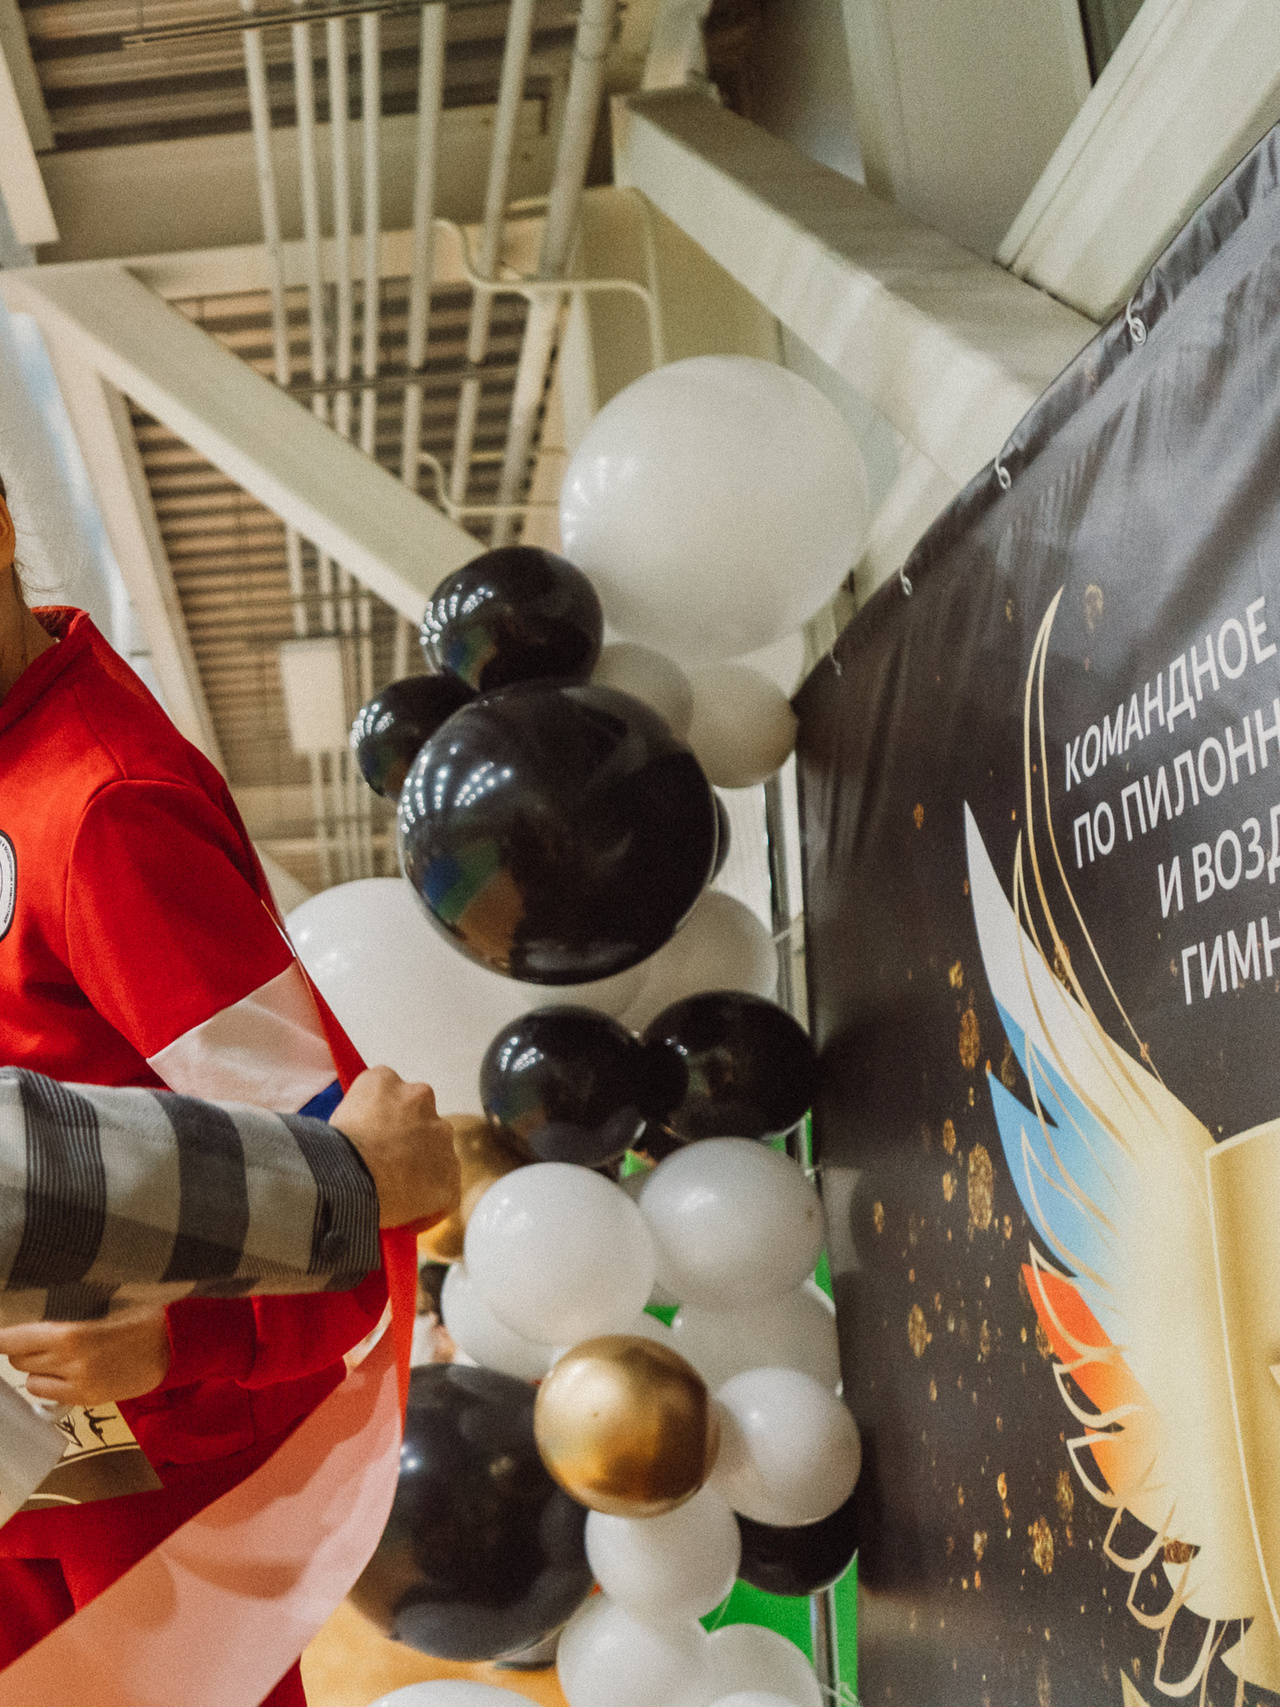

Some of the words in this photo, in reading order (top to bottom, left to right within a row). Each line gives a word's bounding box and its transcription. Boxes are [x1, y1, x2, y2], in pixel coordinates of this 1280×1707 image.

[1065, 596, 1277, 792] КОМАНДНОЕ
[1073, 801, 1116, 870] ПО
[1121, 697, 1280, 842] ПИЛОНН
[1158, 855, 1184, 919] И
